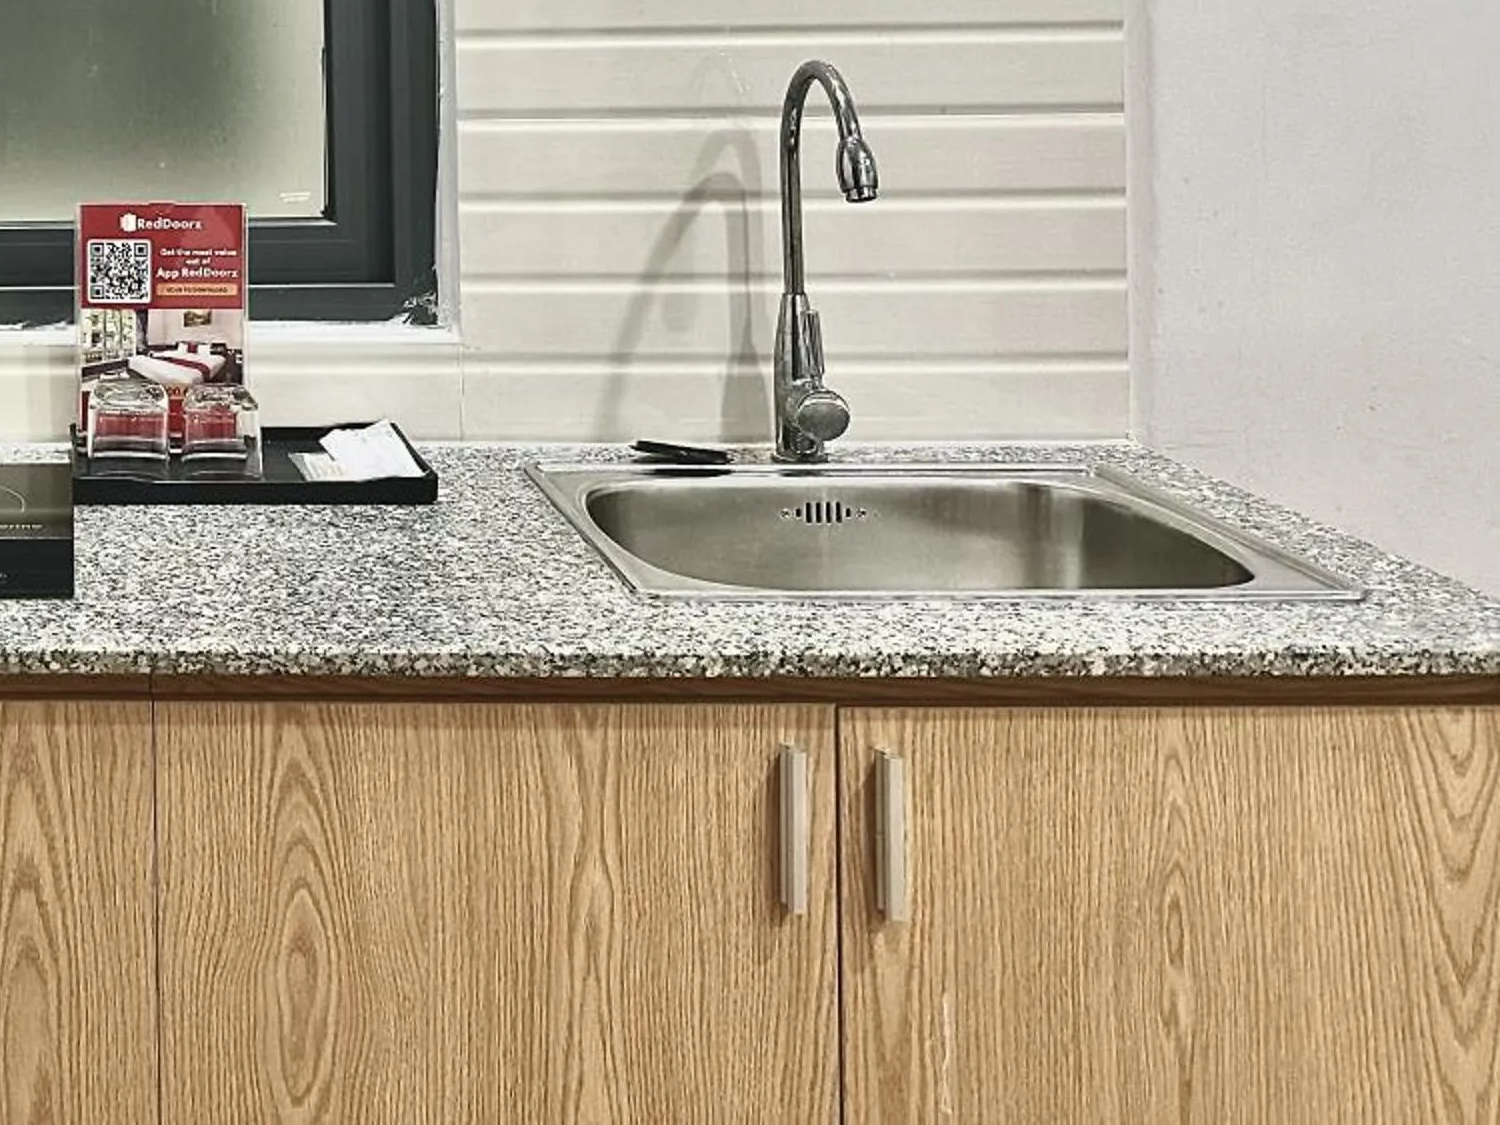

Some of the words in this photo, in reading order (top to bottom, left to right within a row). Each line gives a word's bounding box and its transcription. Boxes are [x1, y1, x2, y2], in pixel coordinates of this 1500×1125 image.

[137, 217, 203, 230] RedDoorz
[159, 247, 175, 256] Get
[156, 266, 180, 279] App
[181, 266, 239, 278] RedDoorz
